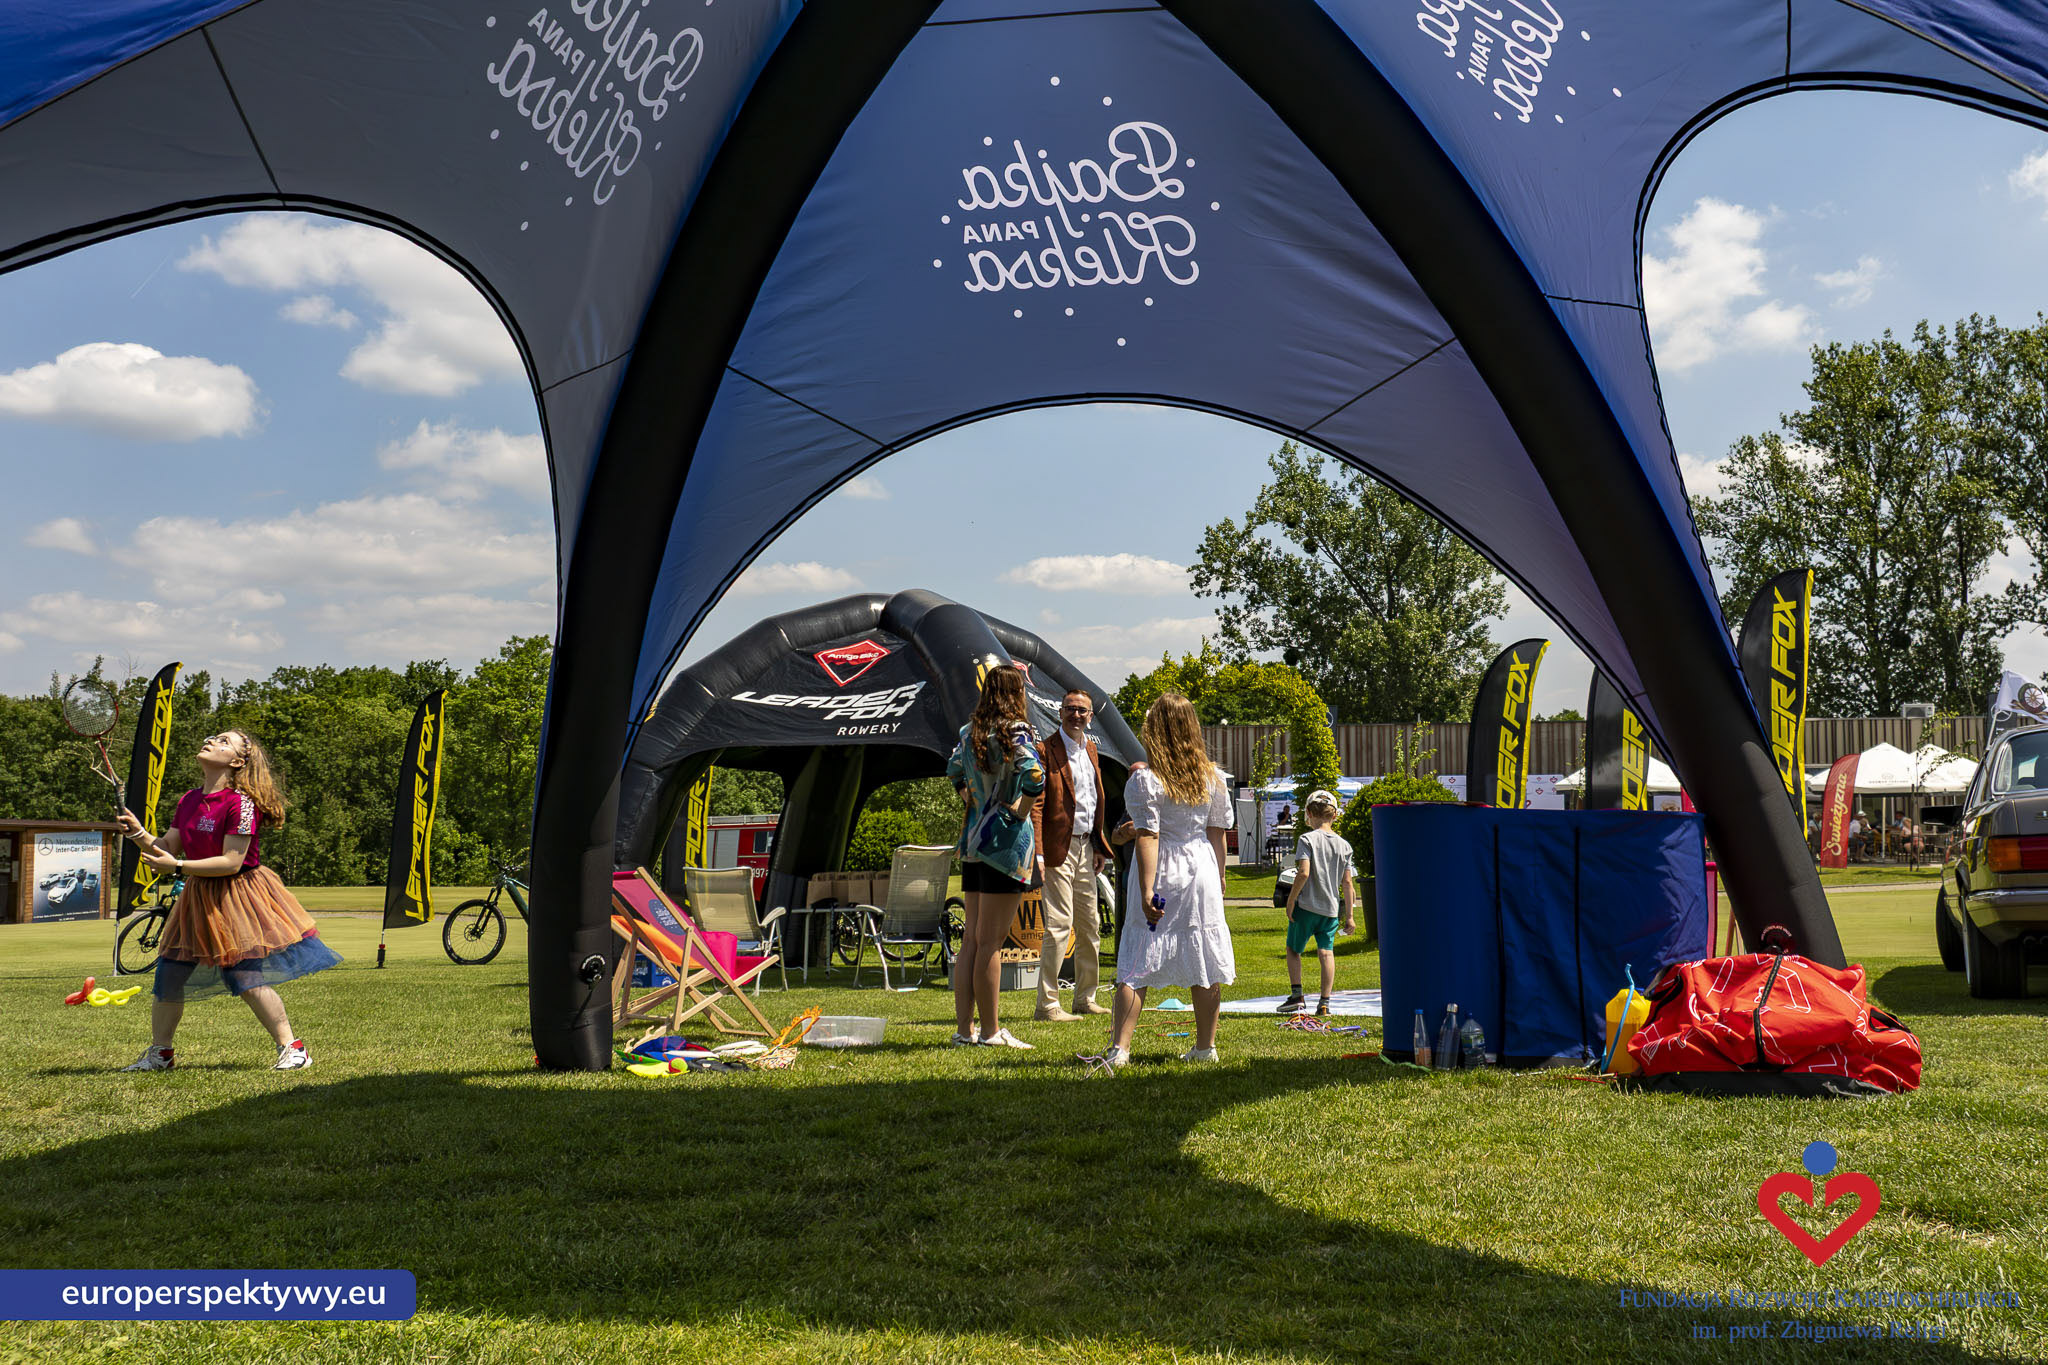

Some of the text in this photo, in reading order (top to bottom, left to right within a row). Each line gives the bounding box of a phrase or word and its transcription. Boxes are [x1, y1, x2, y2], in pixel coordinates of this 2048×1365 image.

[1771, 586, 1797, 681] FOX
[151, 677, 171, 755] FOX
[731, 681, 926, 708] LEADER
[836, 722, 901, 736] ROWERY
[1502, 650, 1530, 730] FOX
[405, 703, 436, 922] LEADER FOX
